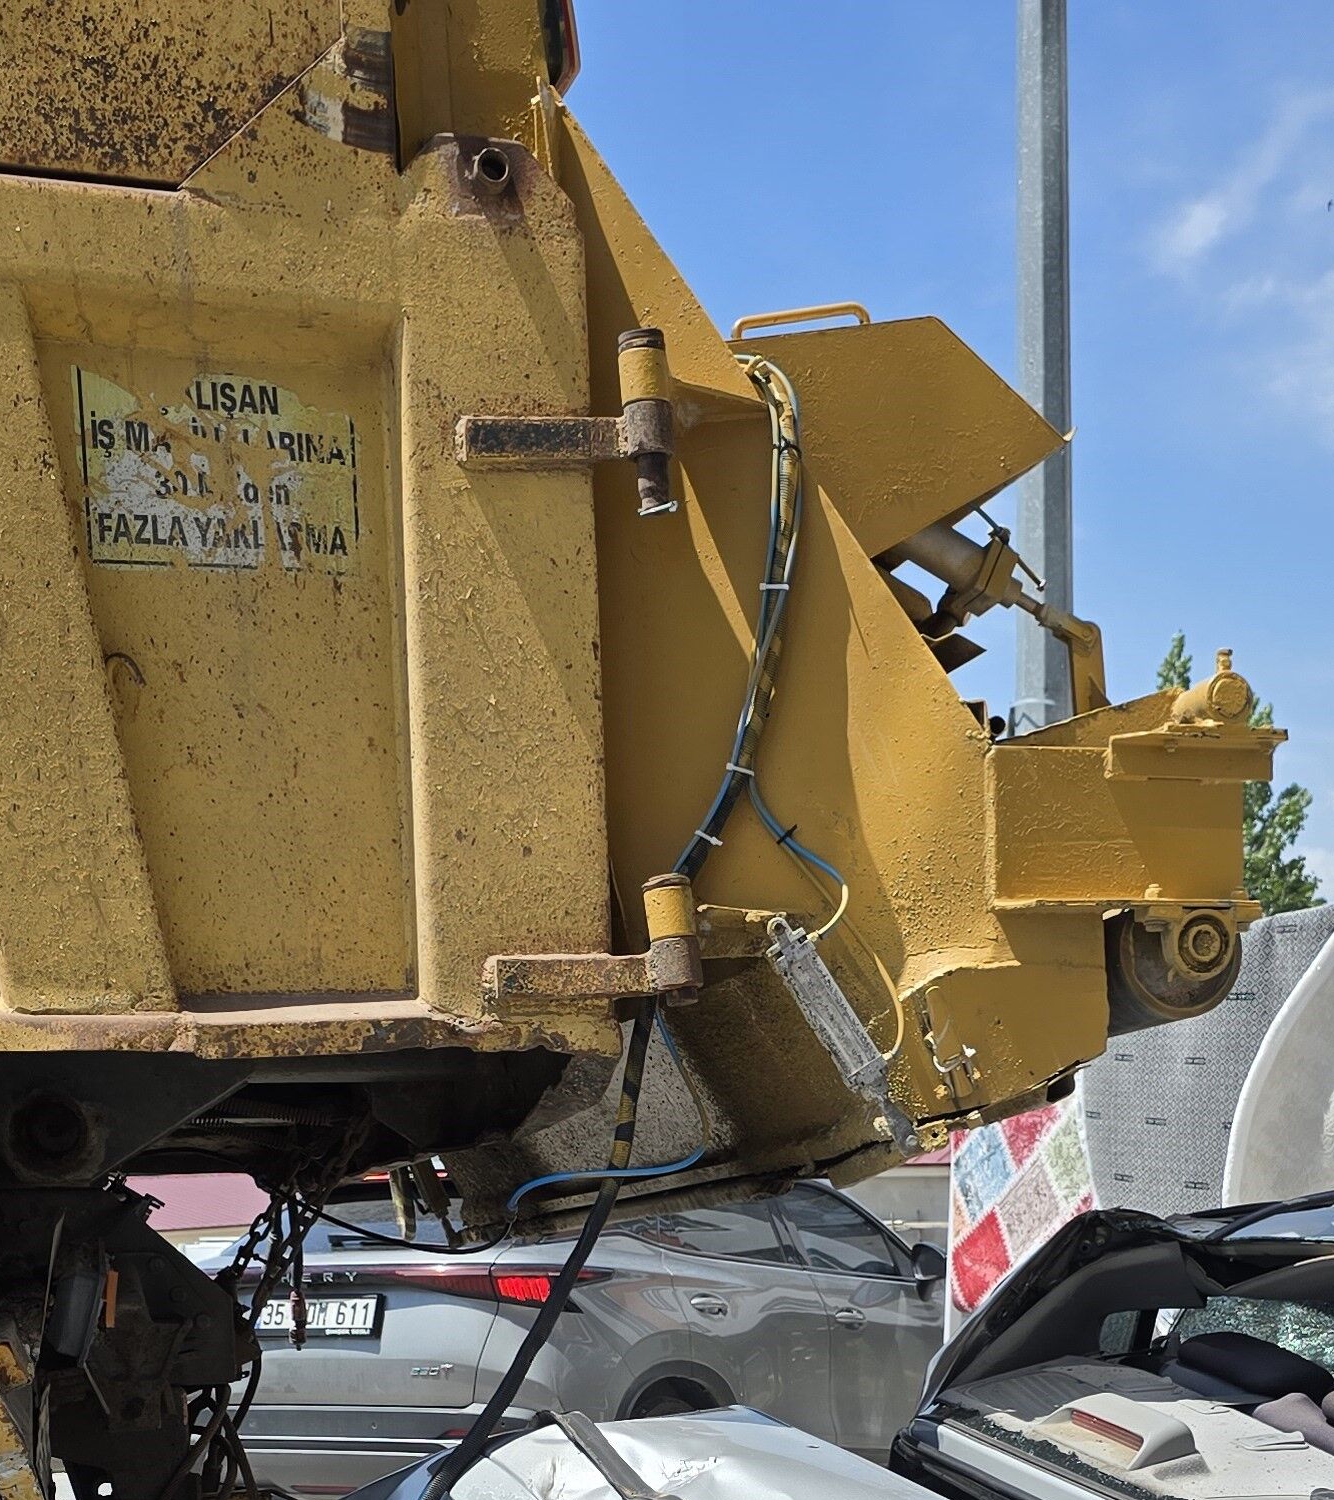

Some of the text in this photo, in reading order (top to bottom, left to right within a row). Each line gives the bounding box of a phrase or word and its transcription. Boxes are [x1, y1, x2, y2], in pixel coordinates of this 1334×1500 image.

[97, 513, 188, 547] FAZLA
[263, 1303, 286, 1326] 35
[336, 1302, 370, 1327] 611
